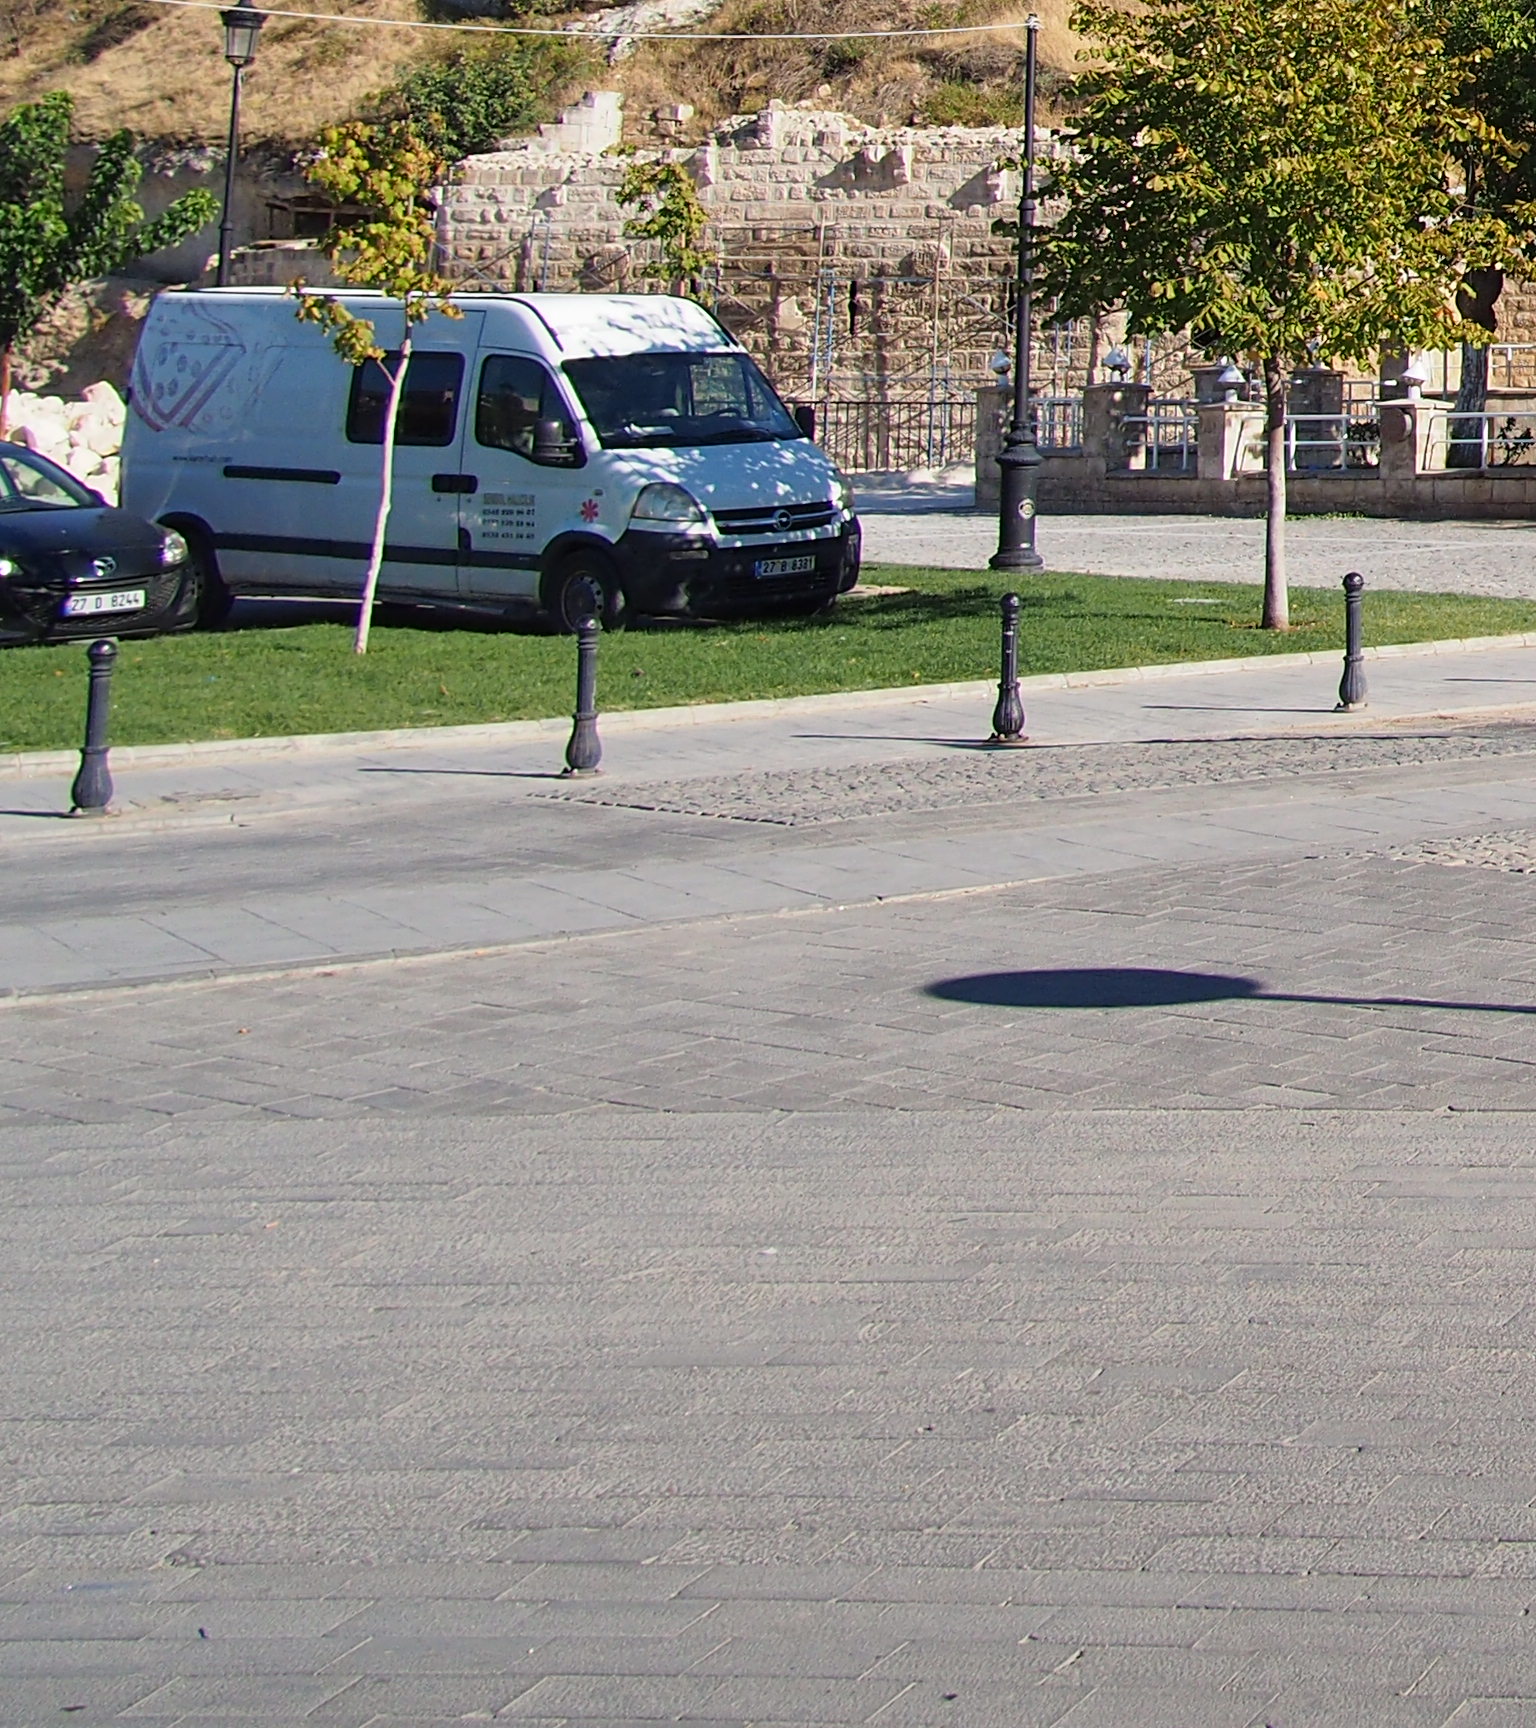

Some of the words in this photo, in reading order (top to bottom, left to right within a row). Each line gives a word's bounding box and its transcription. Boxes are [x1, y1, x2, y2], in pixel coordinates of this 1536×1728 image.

[763, 561, 775, 573] 27
[71, 598, 87, 611] 27
[111, 593, 139, 607] 8244
